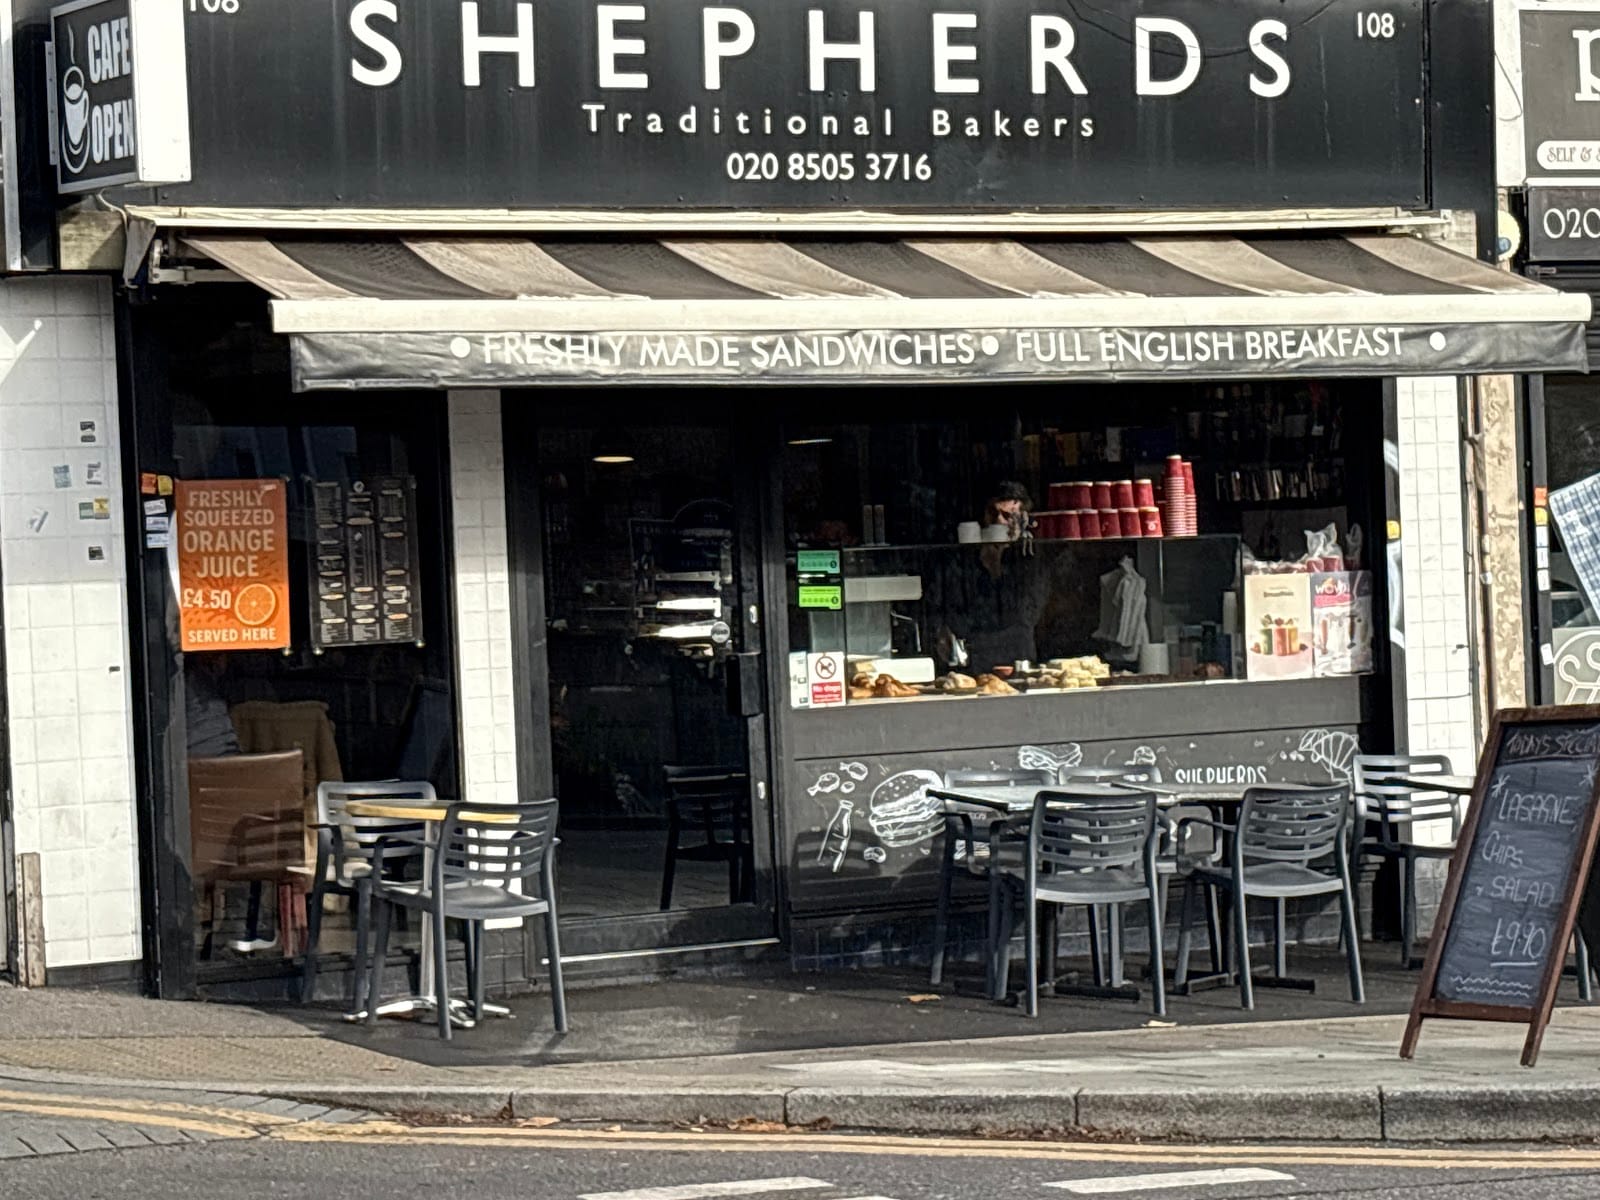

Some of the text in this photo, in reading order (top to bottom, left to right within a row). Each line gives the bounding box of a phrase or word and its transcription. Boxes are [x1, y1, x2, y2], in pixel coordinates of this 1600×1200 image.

[1357, 12, 1395, 38] 108
[88, 17, 131, 84] CAFE
[350, 0, 1291, 98] SHEPHERDS
[91, 99, 135, 164] OPEN
[582, 104, 1094, 137] Traditional Bakers
[726, 152, 932, 181] 020 8505 3716
[483, 327, 1405, 368] FRESHLY MADE SANDWICHES FULL ENGLISH BREAKFAST
[189, 490, 265, 508] FRESHLY
[184, 509, 275, 527] SQUEEZED
[183, 530, 275, 553] ORANGE
[197, 555, 260, 578] JUICE
[183, 588, 232, 609] £4.50
[188, 628, 277, 643] SERVED HERE
